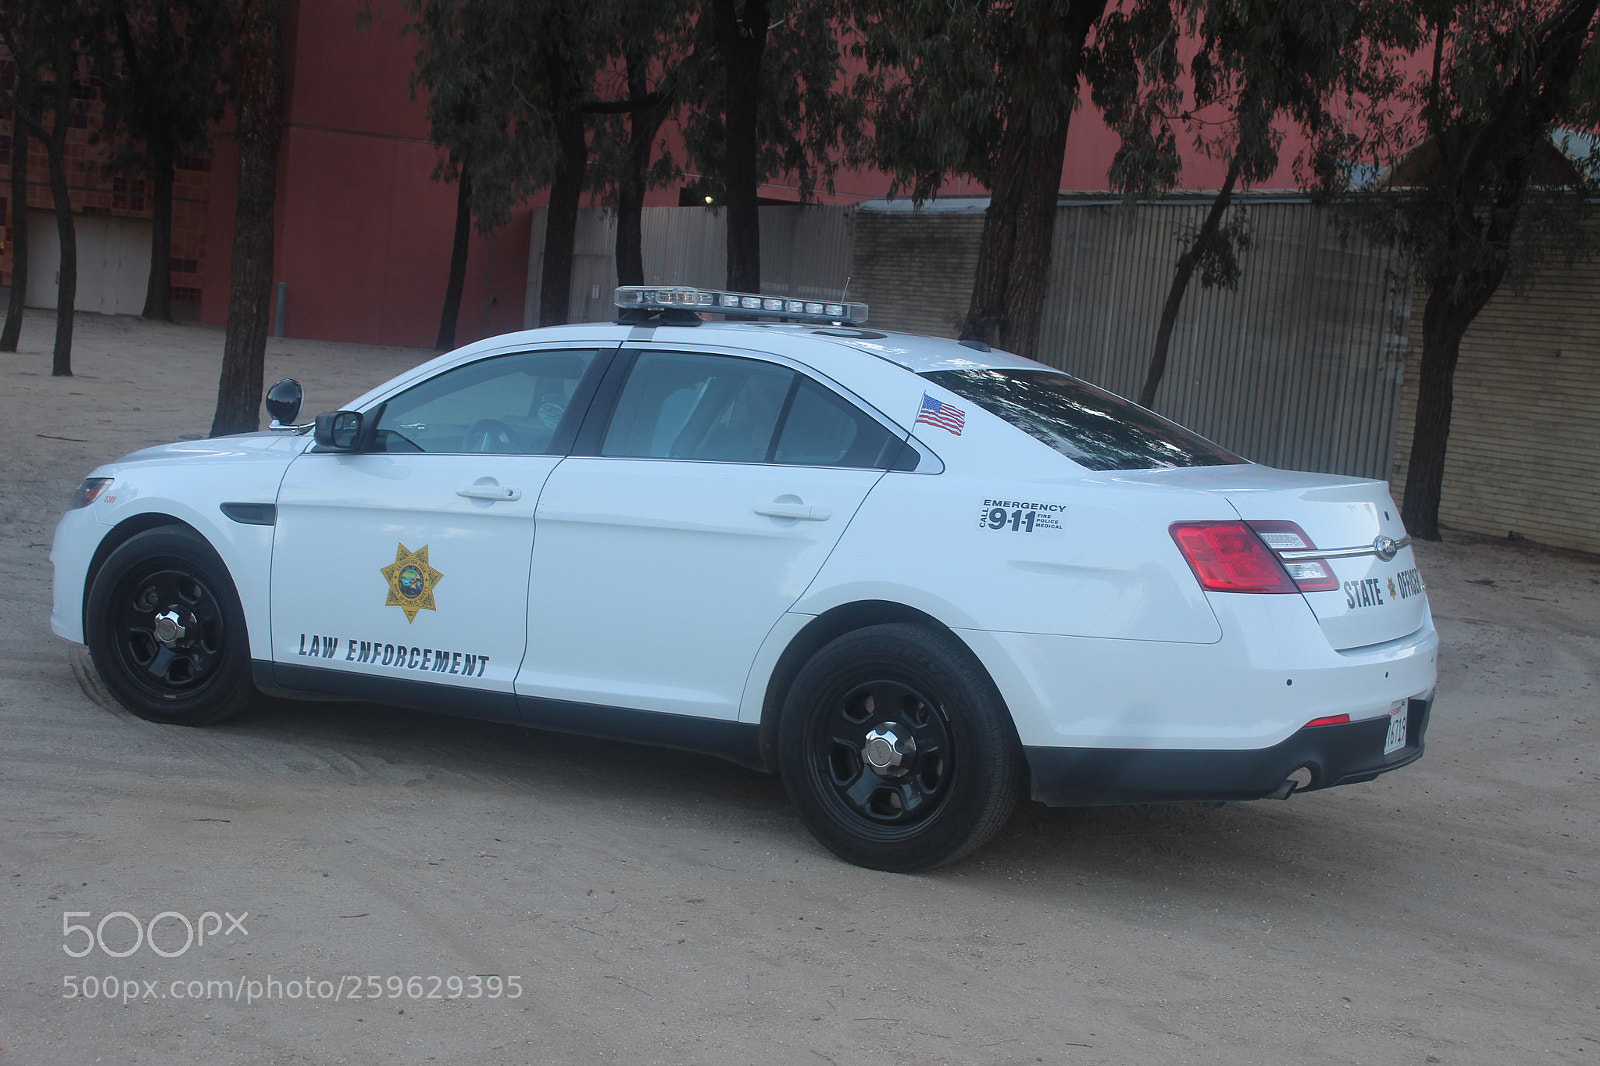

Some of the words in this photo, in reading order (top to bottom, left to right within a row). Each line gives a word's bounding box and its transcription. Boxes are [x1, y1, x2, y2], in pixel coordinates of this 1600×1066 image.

[983, 499, 1067, 512] EMERGENCY
[979, 508, 989, 528] CALL
[988, 507, 1036, 533] 9-1-1
[1343, 578, 1384, 609] STATE
[298, 633, 339, 659] LAW
[345, 639, 490, 678] ENFORCEMENT
